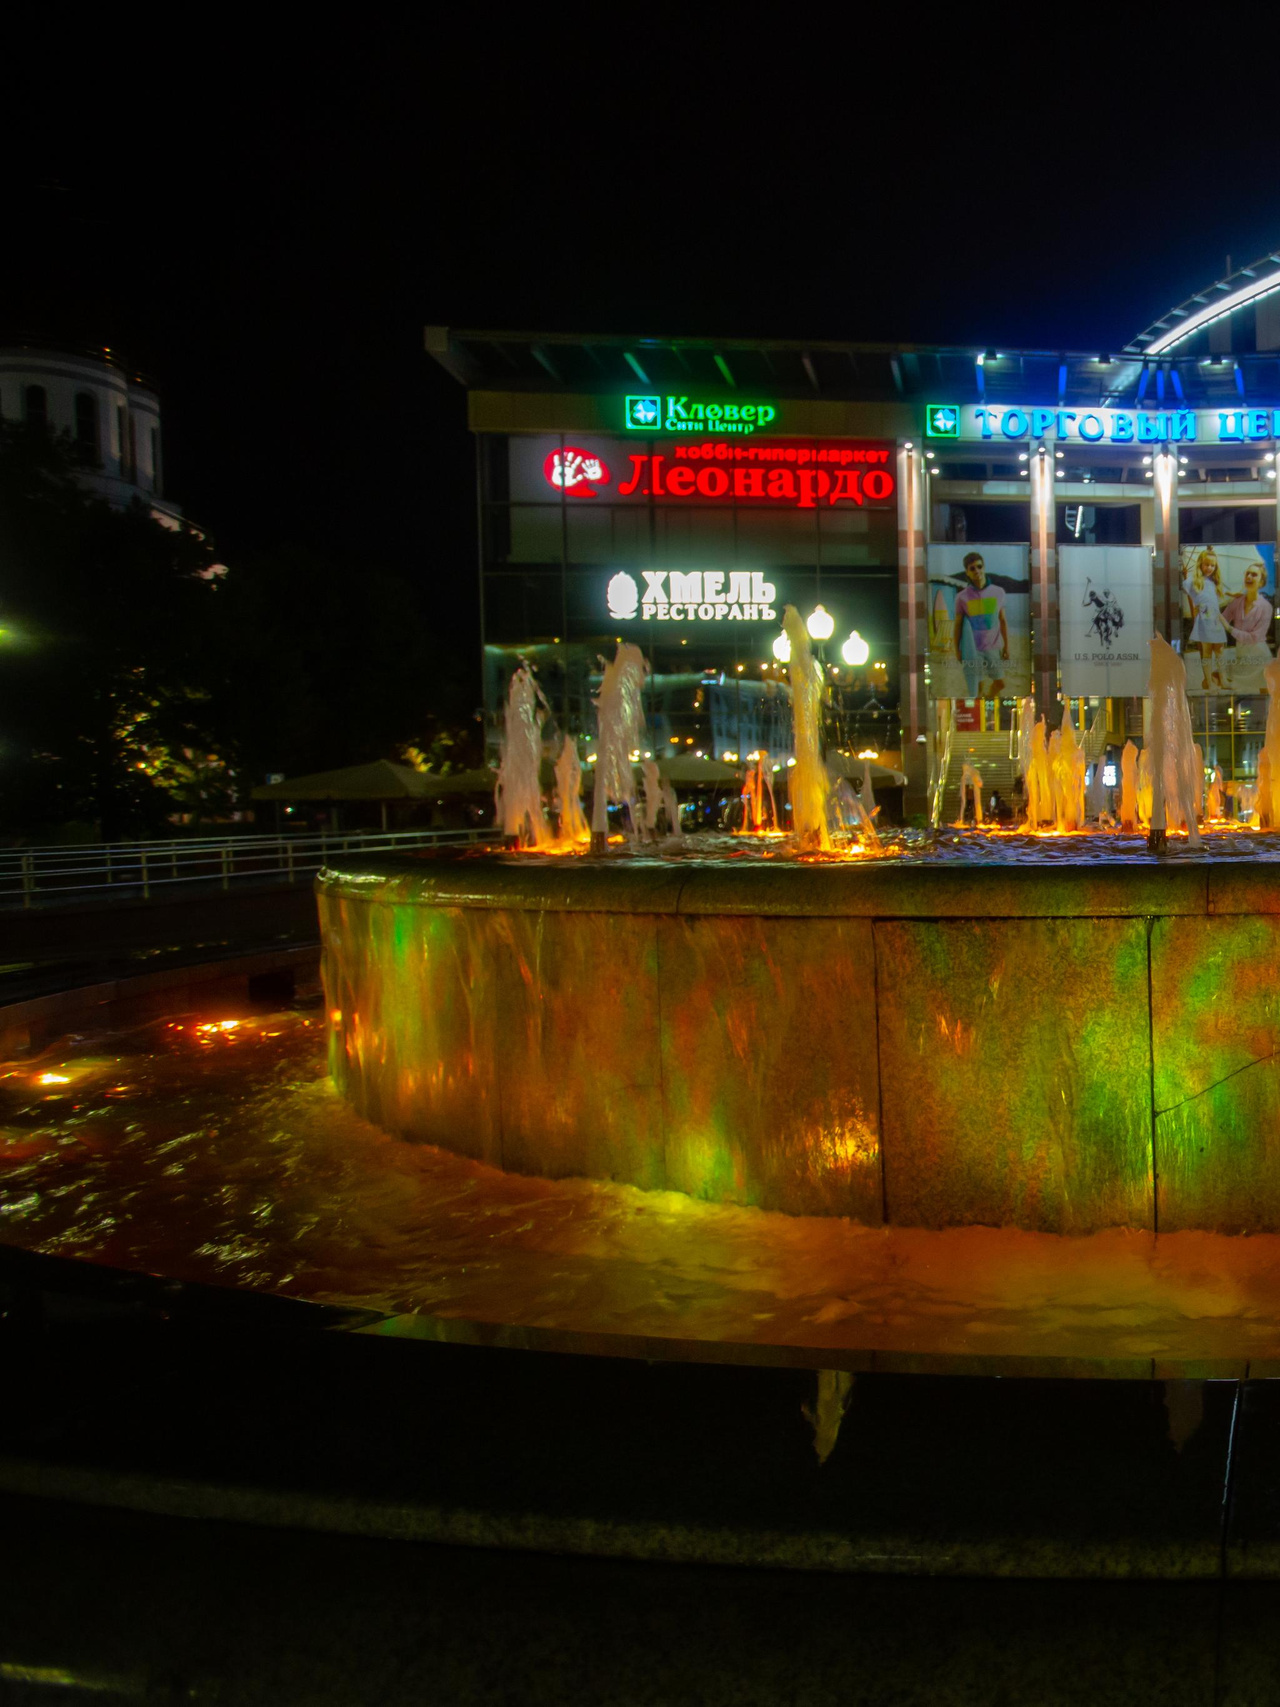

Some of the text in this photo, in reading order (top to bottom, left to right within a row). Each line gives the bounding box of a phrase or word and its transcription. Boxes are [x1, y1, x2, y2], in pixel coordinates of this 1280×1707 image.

[666, 396, 776, 426] Кловер
[664, 418, 754, 434] Сити Центр
[975, 408, 1196, 443] ТОРГОВЫЙ
[674, 443, 890, 465] хобби-гипермаркет
[618, 455, 895, 507] Леонардо
[641, 571, 777, 604] ХМЕЛЬ
[642, 603, 777, 621] РЕСТОРАНЪ
[1091, 653, 1115, 661] POLO
